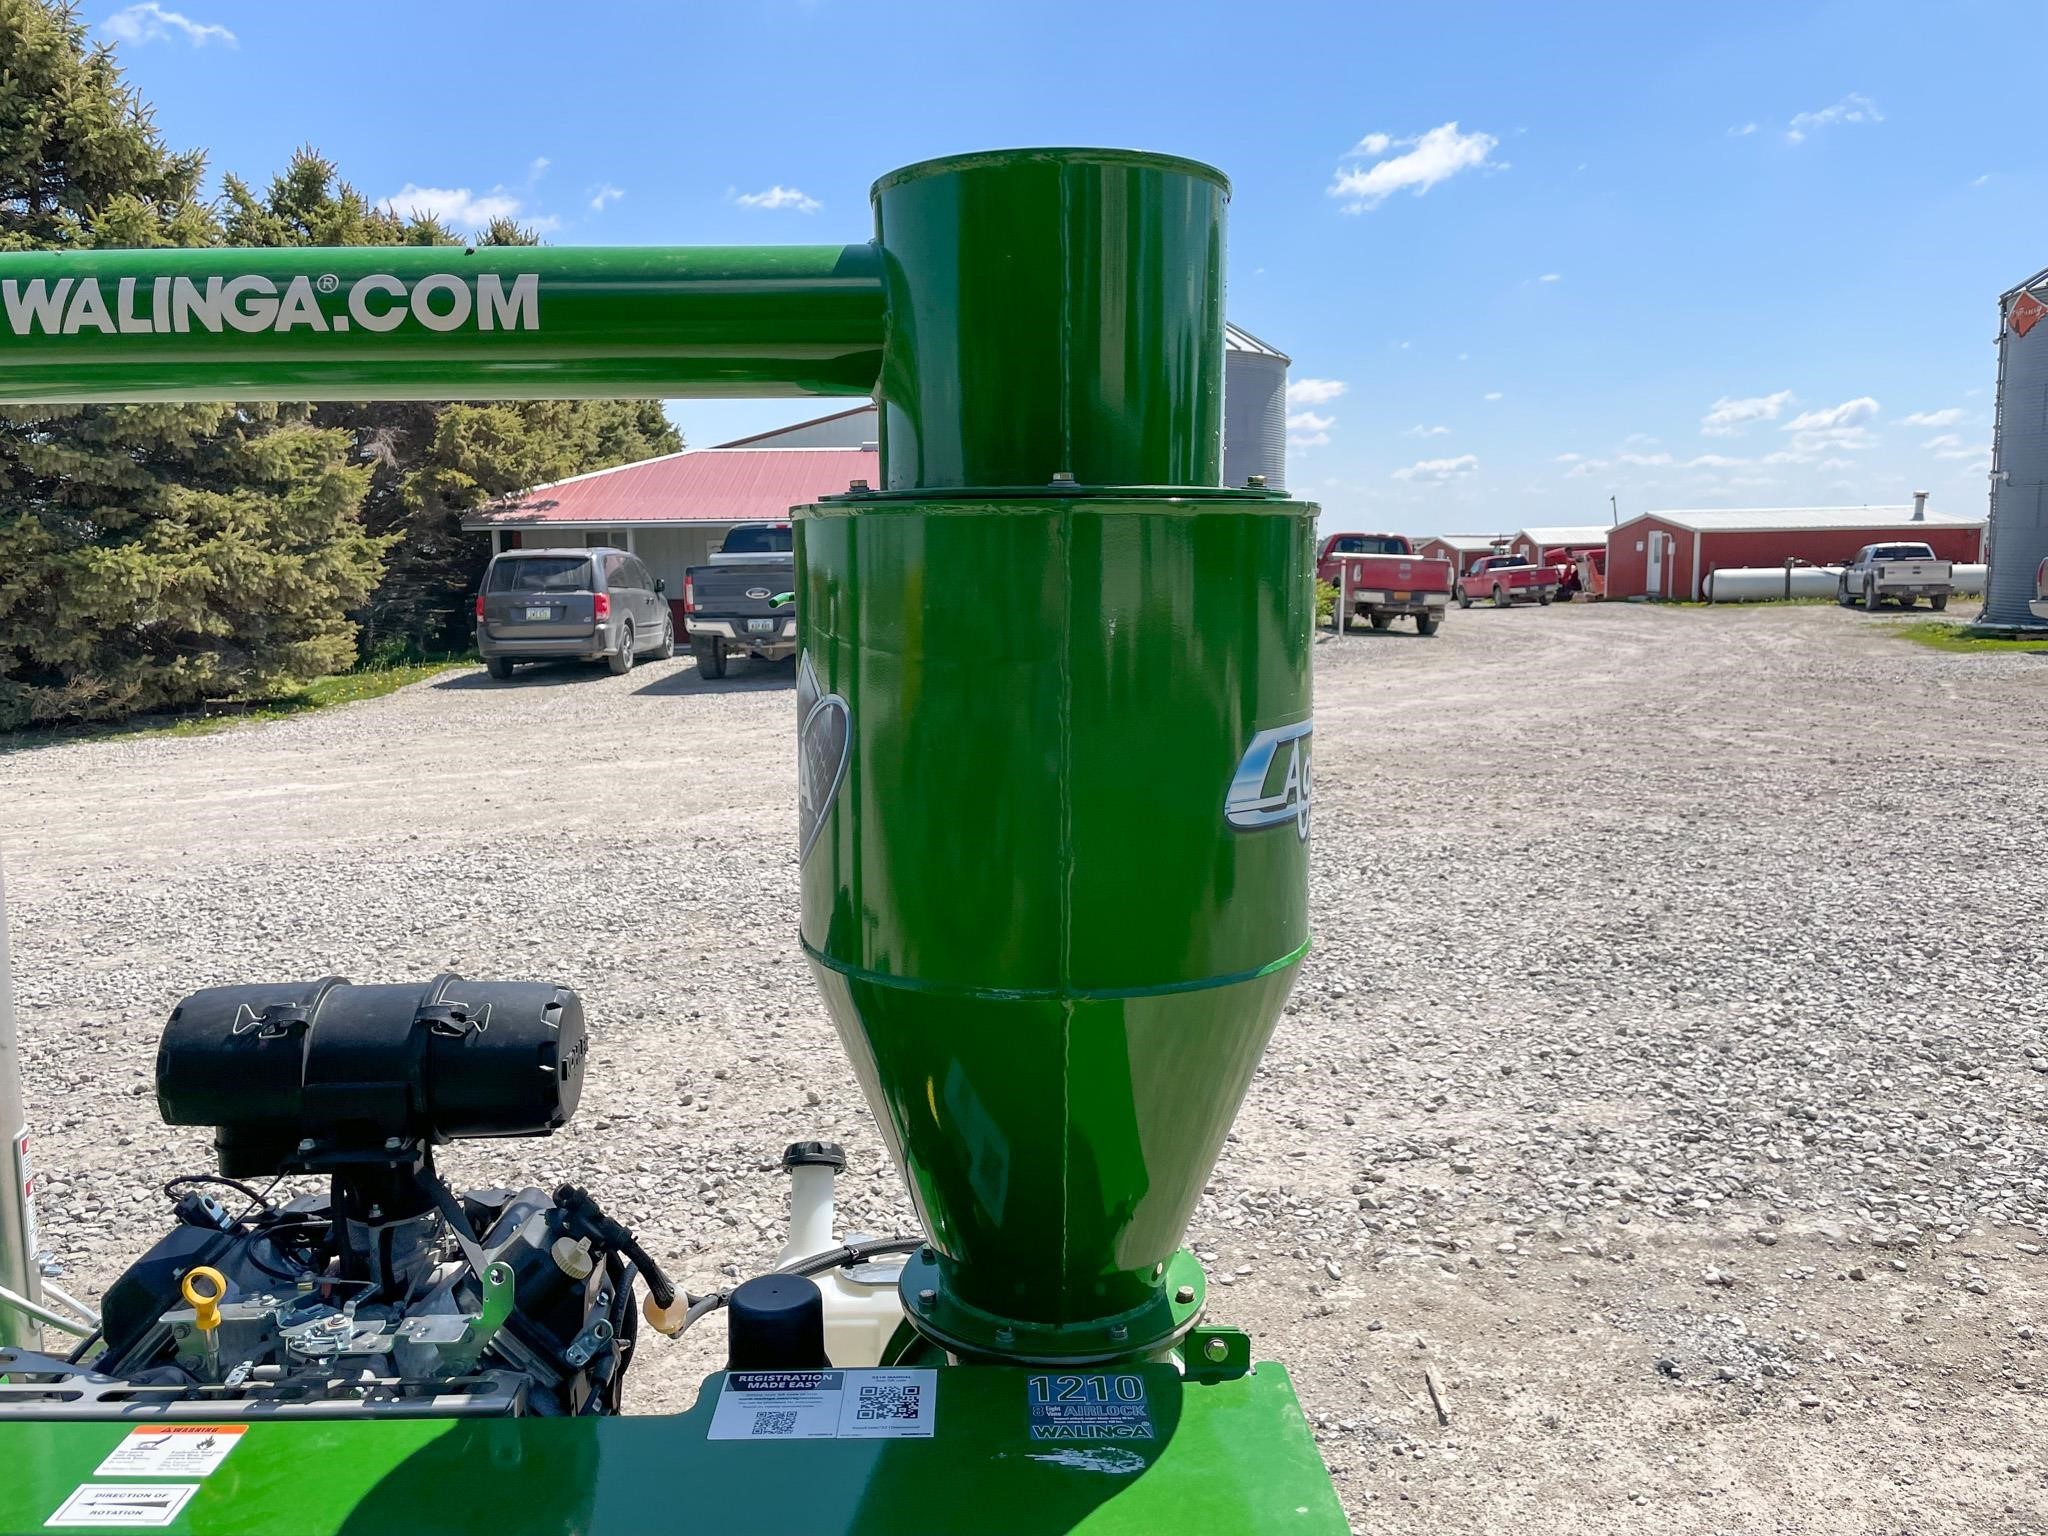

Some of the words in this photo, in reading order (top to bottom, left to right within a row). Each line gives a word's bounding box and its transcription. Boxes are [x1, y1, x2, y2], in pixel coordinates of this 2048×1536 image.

[738, 1374, 833, 1382] REGISTRATION
[747, 1381, 785, 1389] MADE
[1030, 1375, 1143, 1402] 1210
[1063, 1405, 1146, 1417] AIRLOCK
